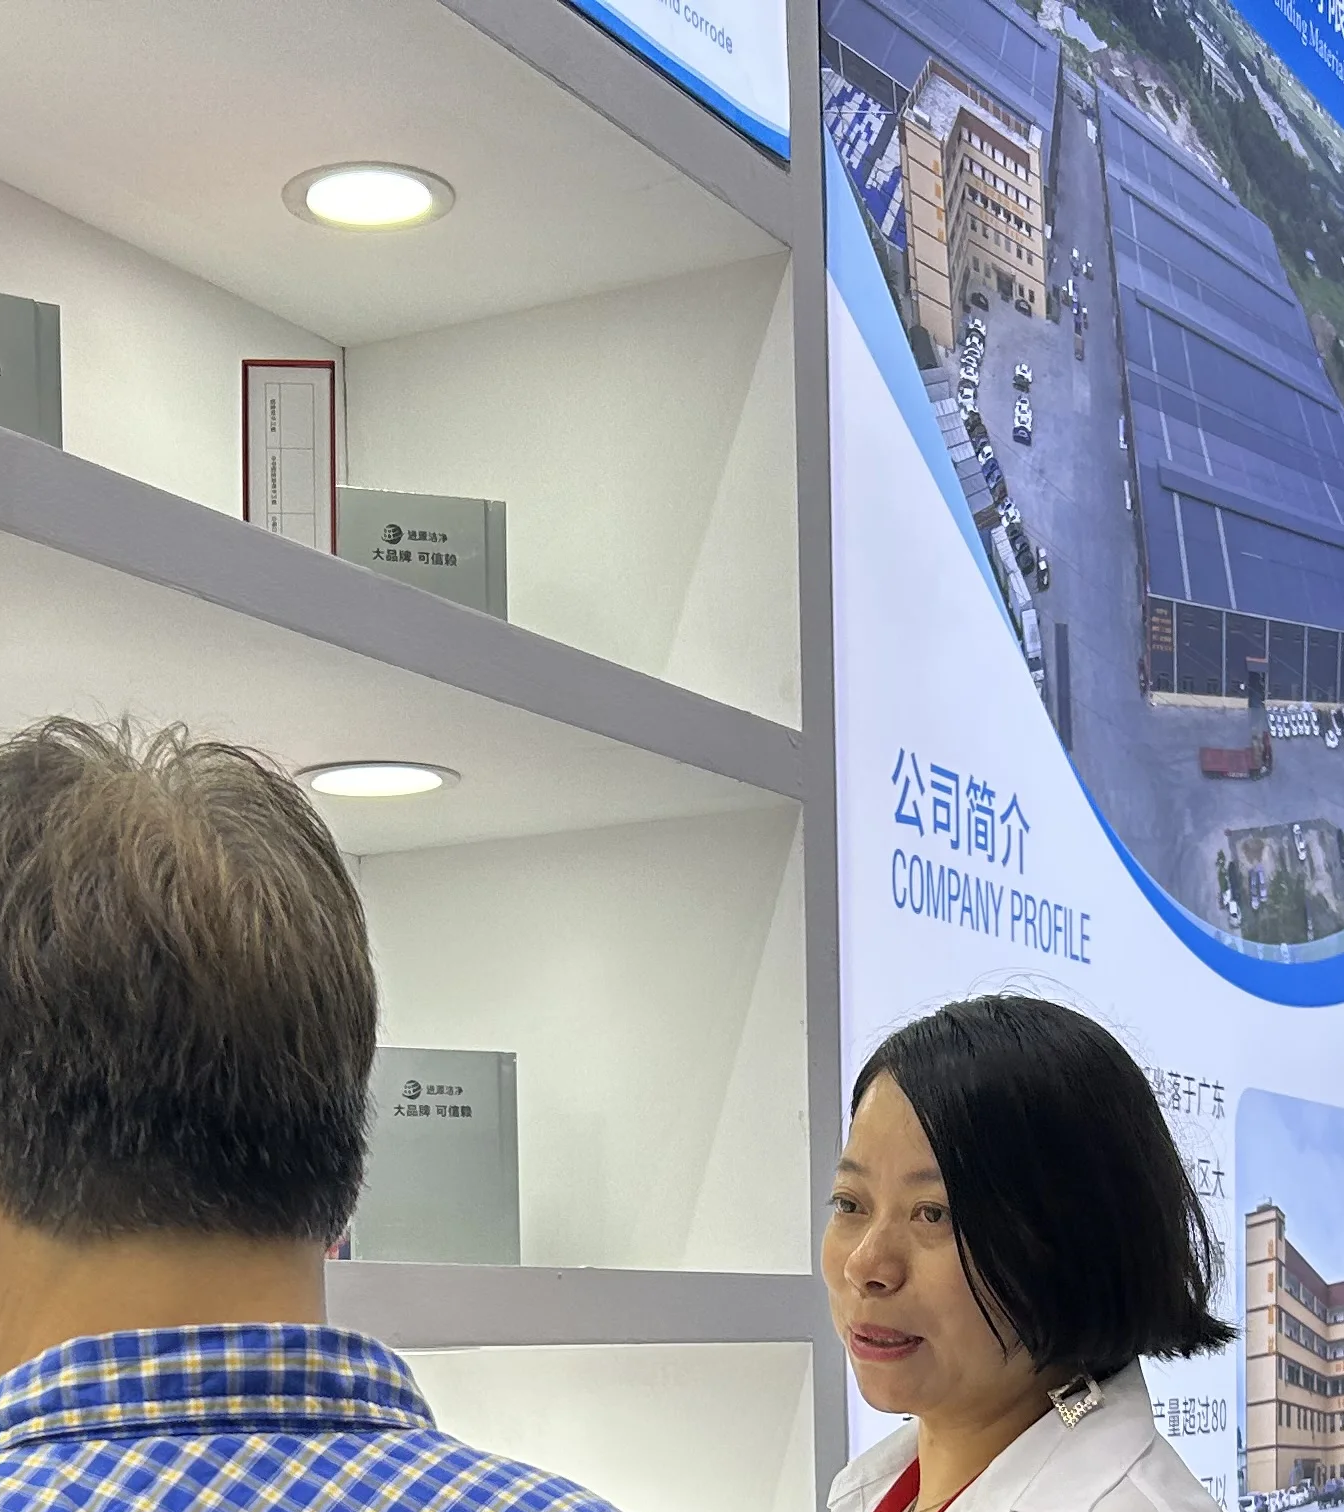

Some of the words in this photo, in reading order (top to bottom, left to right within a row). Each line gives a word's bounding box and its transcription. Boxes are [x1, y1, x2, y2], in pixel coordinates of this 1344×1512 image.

[684, 5, 733, 54] corrode
[890, 746, 1031, 875] 公司简介
[891, 847, 1004, 938] COMPANY
[1010, 889, 1092, 966] PROFILE
